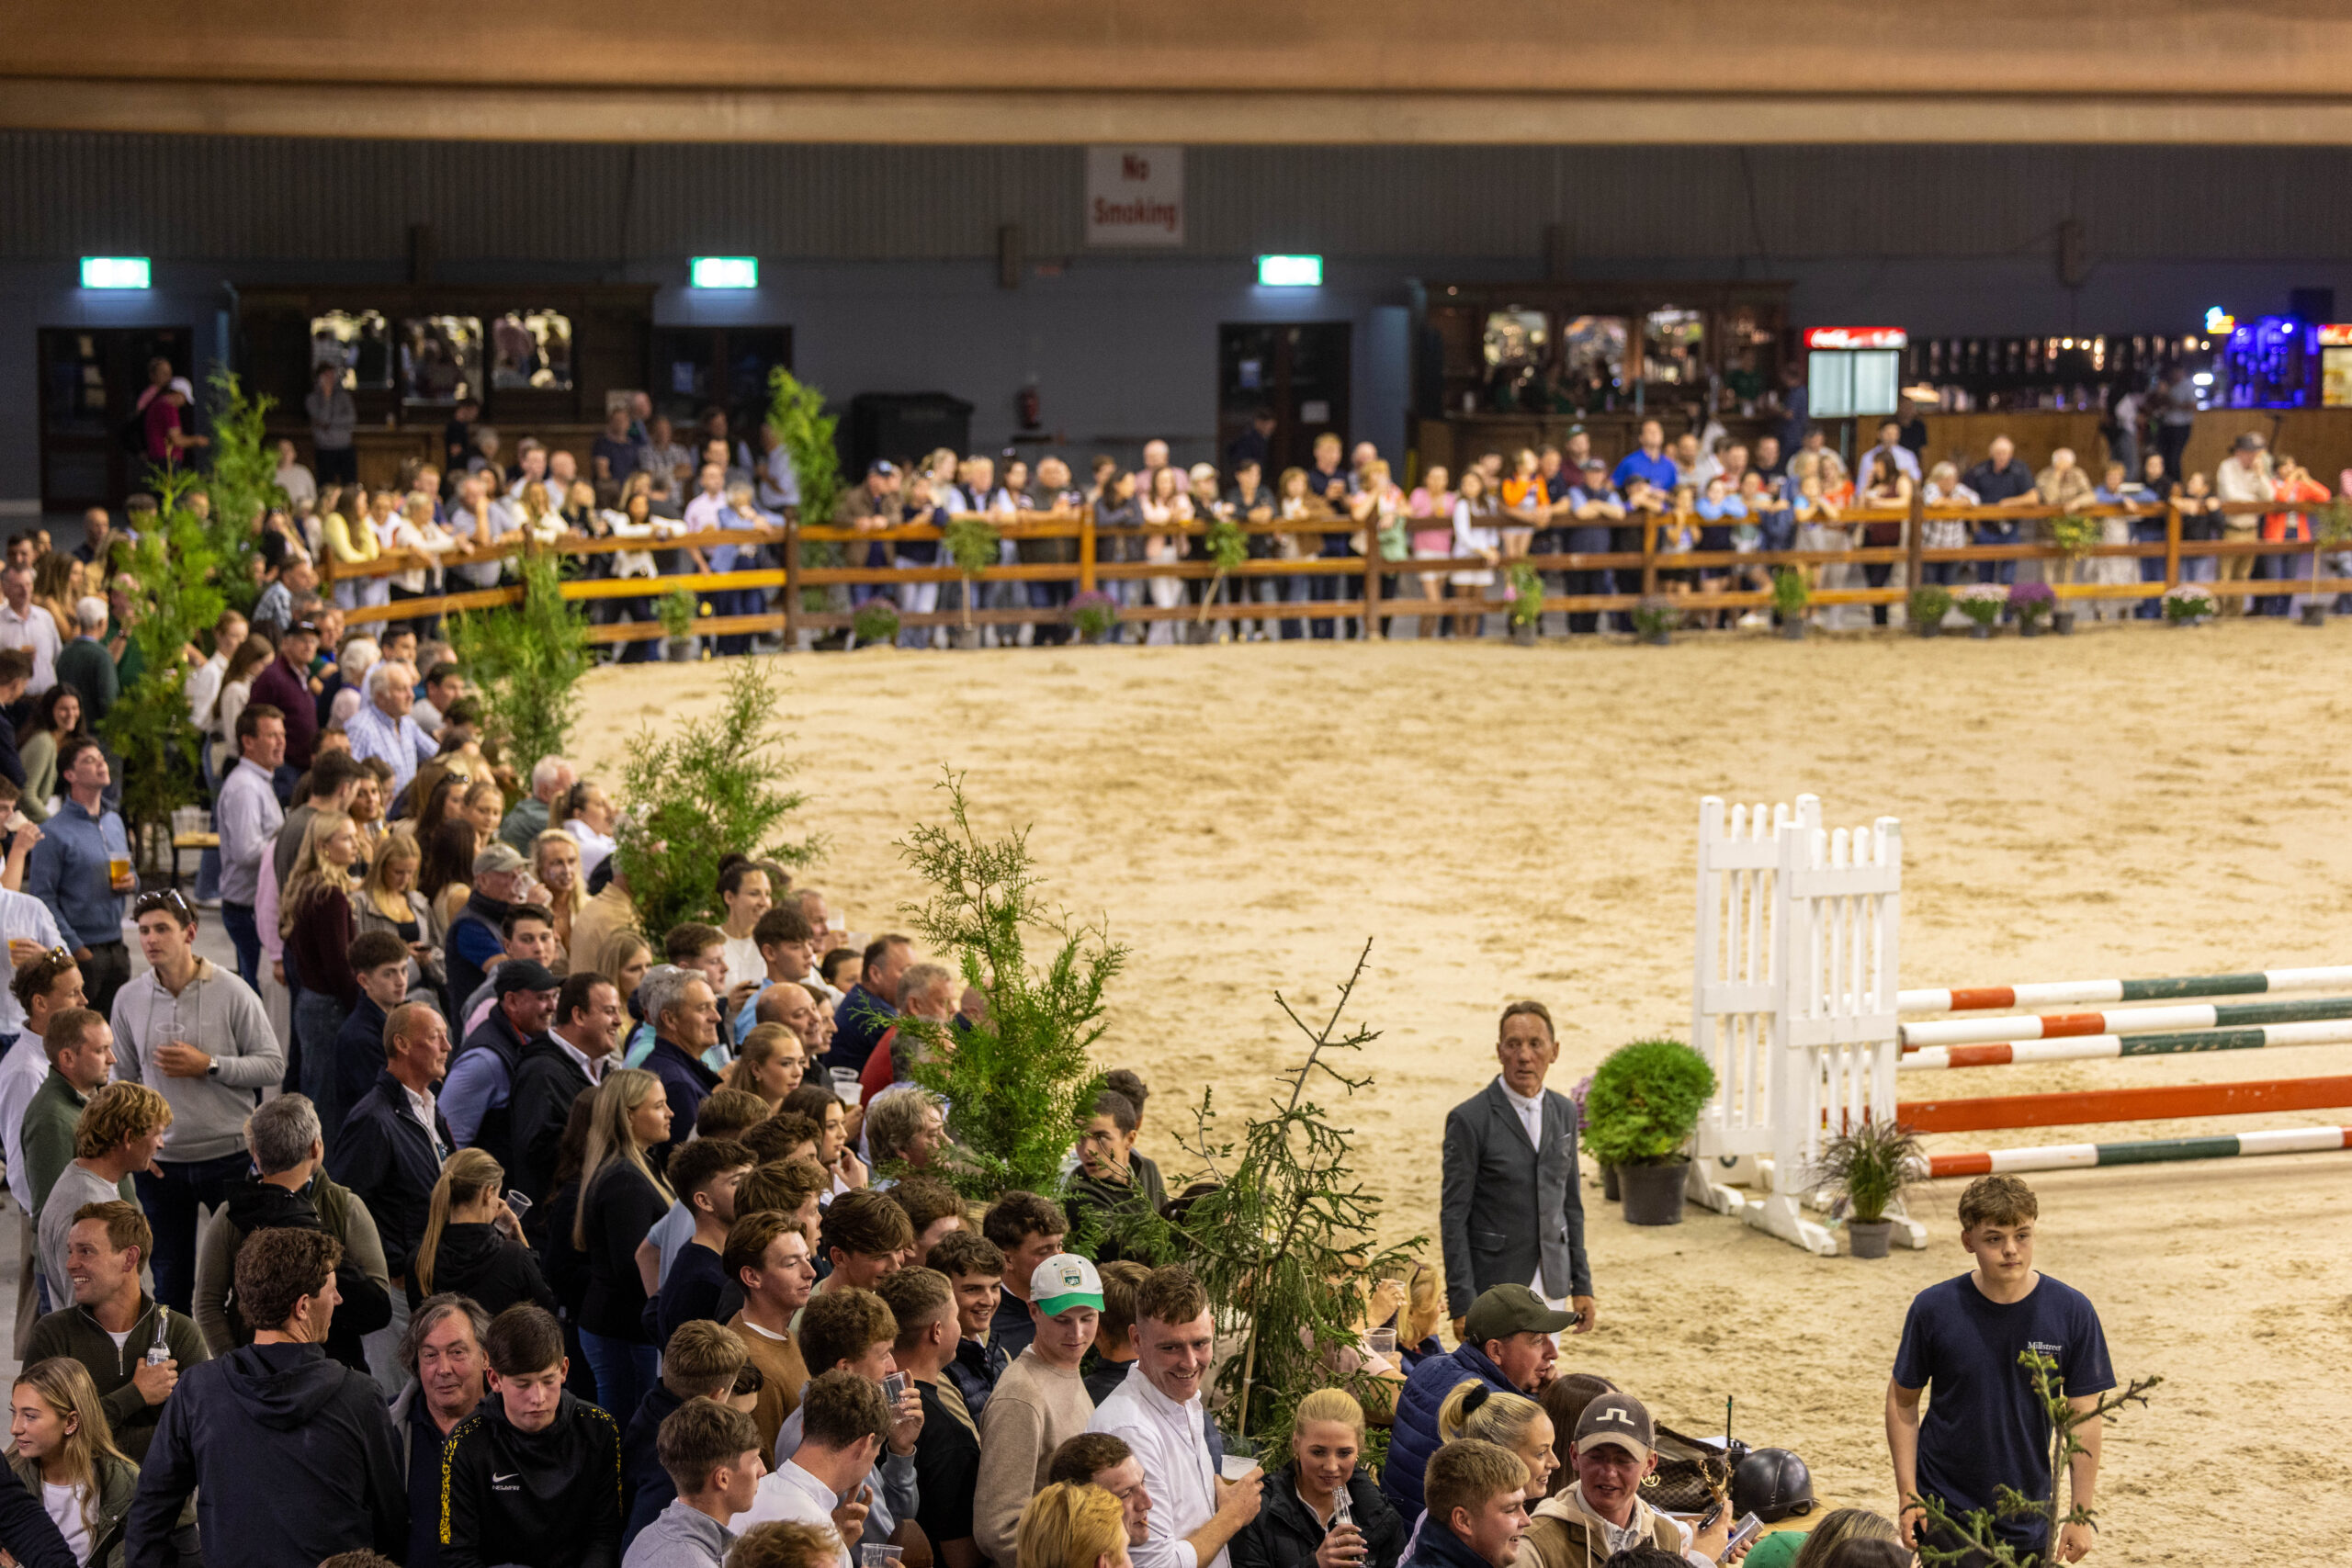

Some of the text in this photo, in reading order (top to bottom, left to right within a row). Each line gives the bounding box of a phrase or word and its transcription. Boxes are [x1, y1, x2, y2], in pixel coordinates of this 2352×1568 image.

[1123, 154, 1149, 181] No
[1094, 197, 1175, 231] Smoking
[2027, 1341, 2062, 1351] Millstreet
